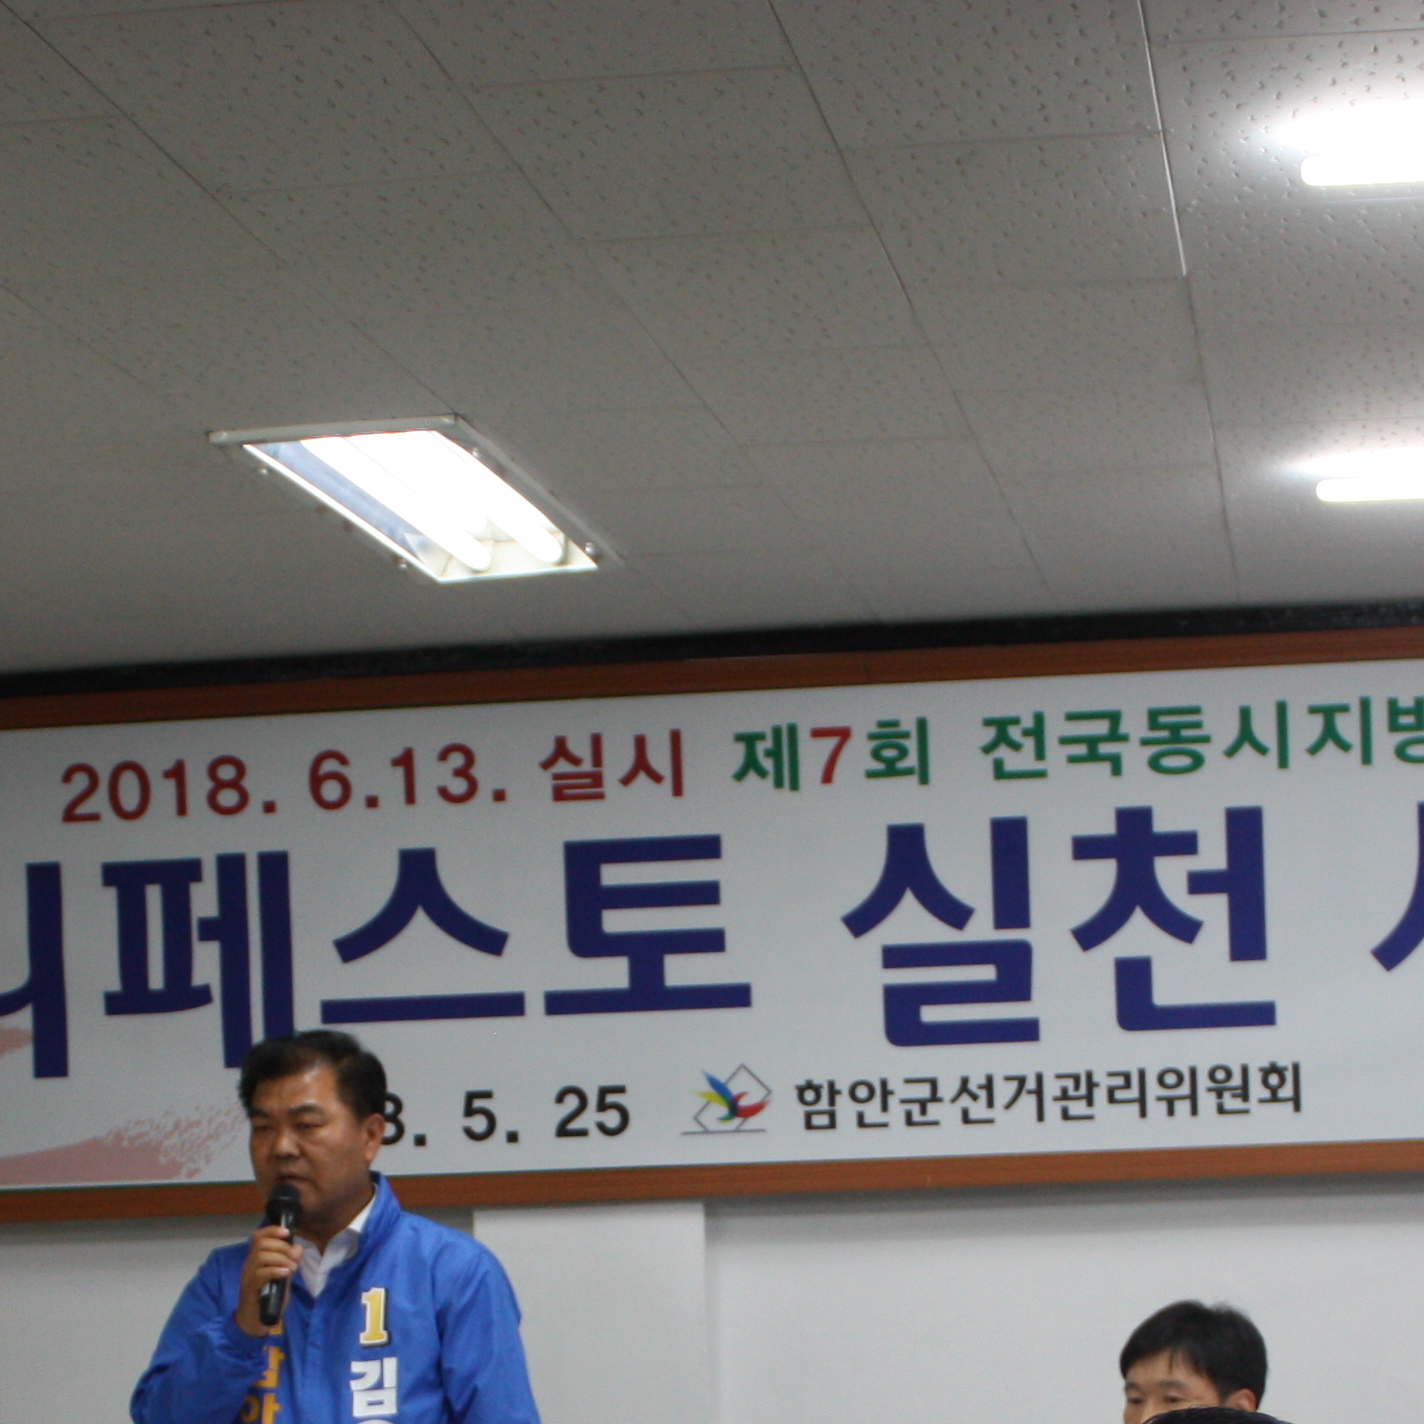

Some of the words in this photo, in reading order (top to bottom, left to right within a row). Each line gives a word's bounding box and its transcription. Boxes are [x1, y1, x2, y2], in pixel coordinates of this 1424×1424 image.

[60, 754, 278, 824] 2018.
[307, 741, 508, 811] 6.13.
[538, 728, 684, 803] 실시
[732, 716, 933, 791] 제7회
[840, 805, 1279, 1050] 실천
[462, 1089, 519, 1143] 5.
[554, 1084, 630, 1138] 25
[794, 1060, 1303, 1131] 함안군선거관리위원회
[358, 1285, 390, 1348] 1
